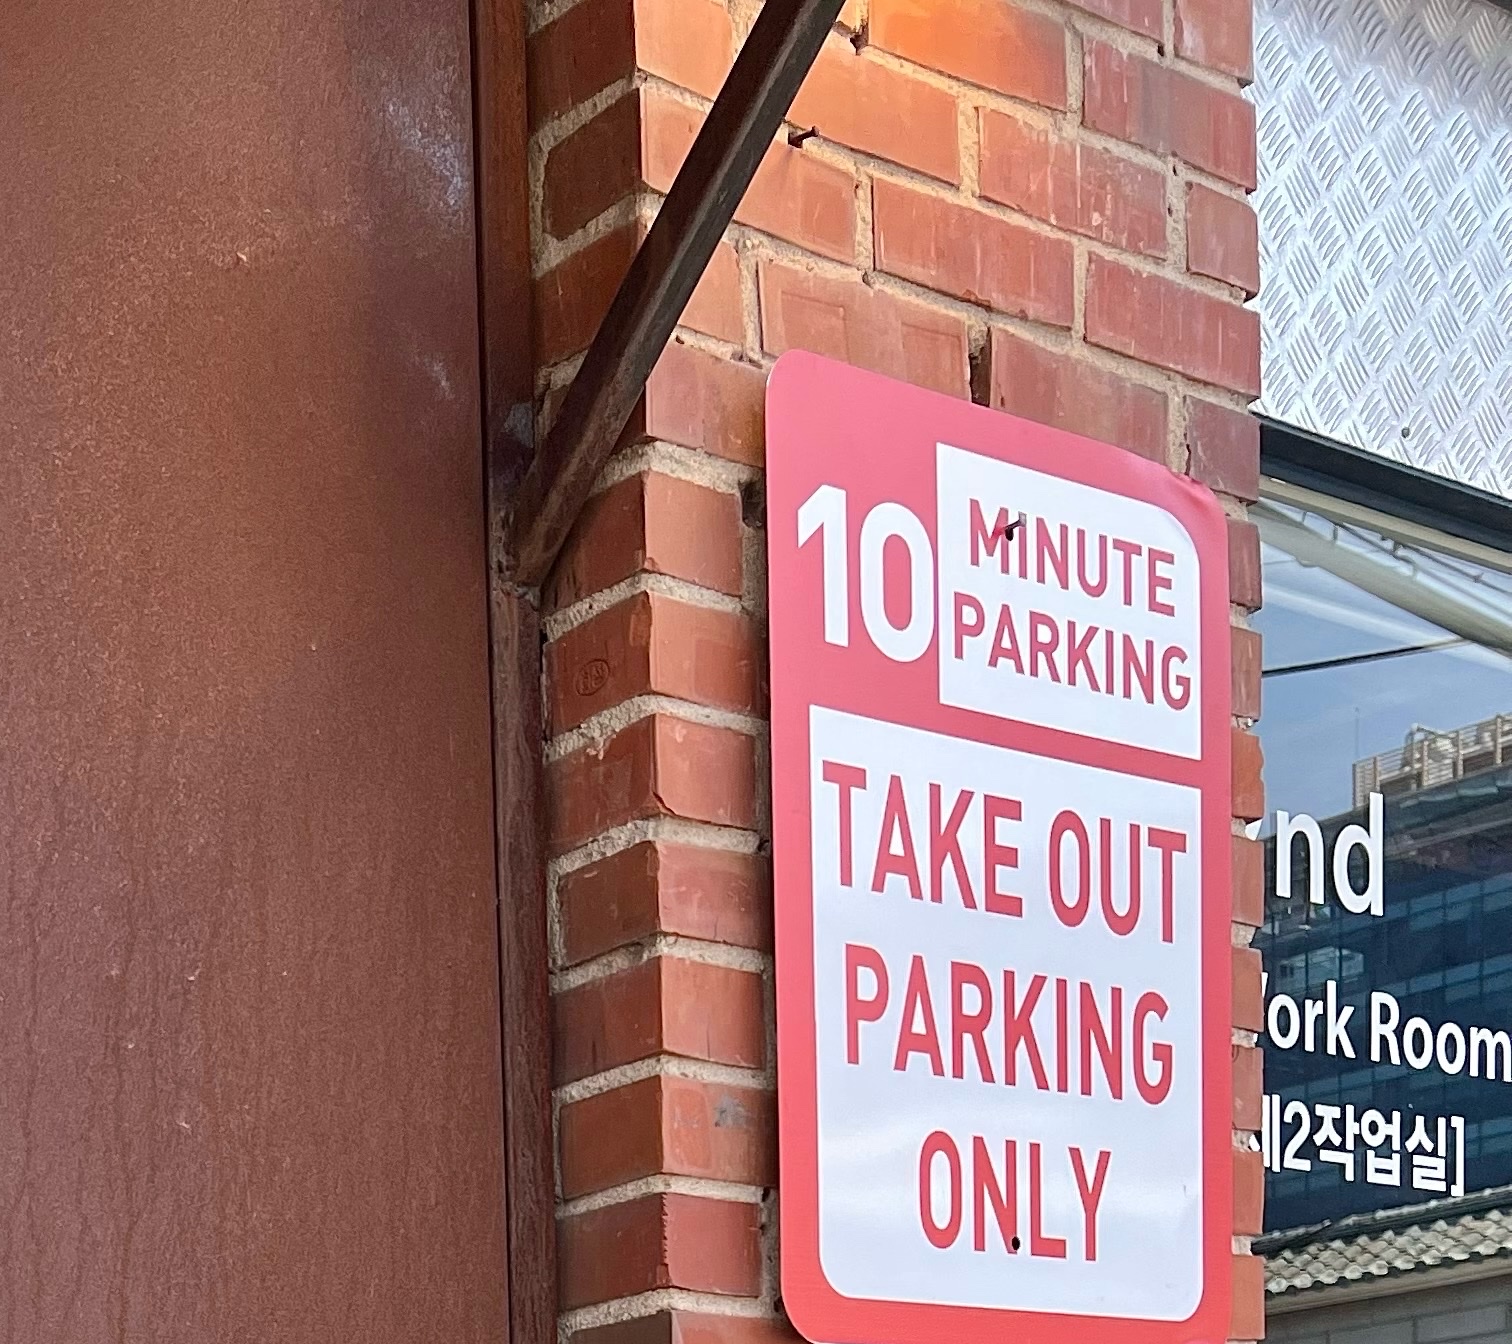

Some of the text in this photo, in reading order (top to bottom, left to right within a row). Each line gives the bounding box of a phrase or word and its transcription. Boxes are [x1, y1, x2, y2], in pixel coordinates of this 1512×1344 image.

[798, 485, 934, 661] 10
[970, 500, 1174, 615] MINUTE
[954, 592, 1190, 709] PARKING
[823, 761, 1186, 942] TAKE OUT
[1245, 792, 1383, 916] nd
[845, 944, 1173, 1104] PARKING
[1258, 973, 1511, 1082] ork Room
[919, 1130, 1111, 1261] ONLY
